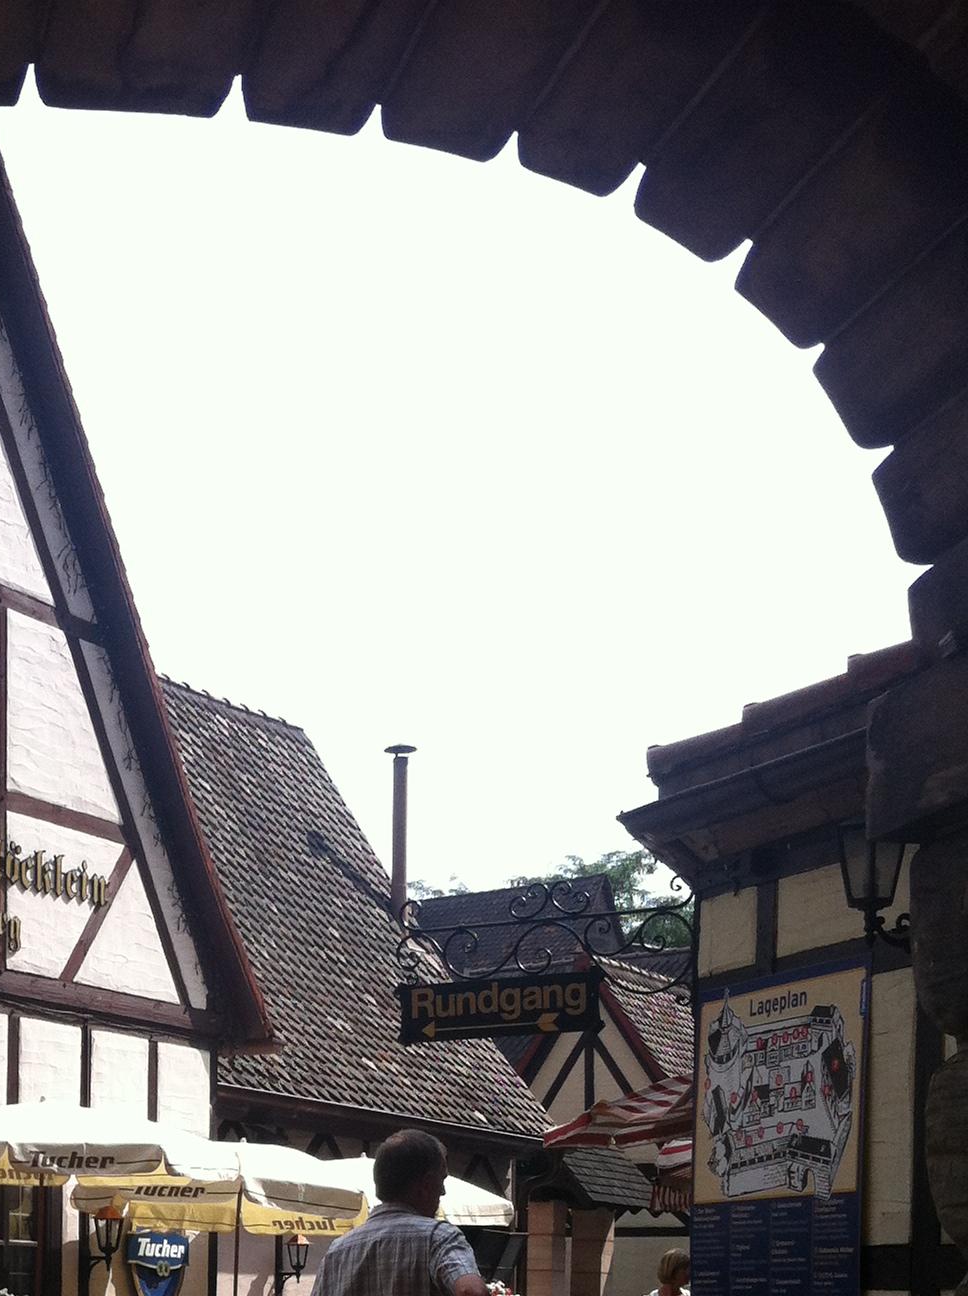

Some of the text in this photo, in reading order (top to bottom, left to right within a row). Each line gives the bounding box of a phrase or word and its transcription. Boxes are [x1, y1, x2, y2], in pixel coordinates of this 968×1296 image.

[410, 980, 587, 1020] Rundgang
[749, 990, 808, 1017] Lageplan
[30, 1150, 116, 1170] Tucher
[138, 1237, 185, 1258] Tucher
